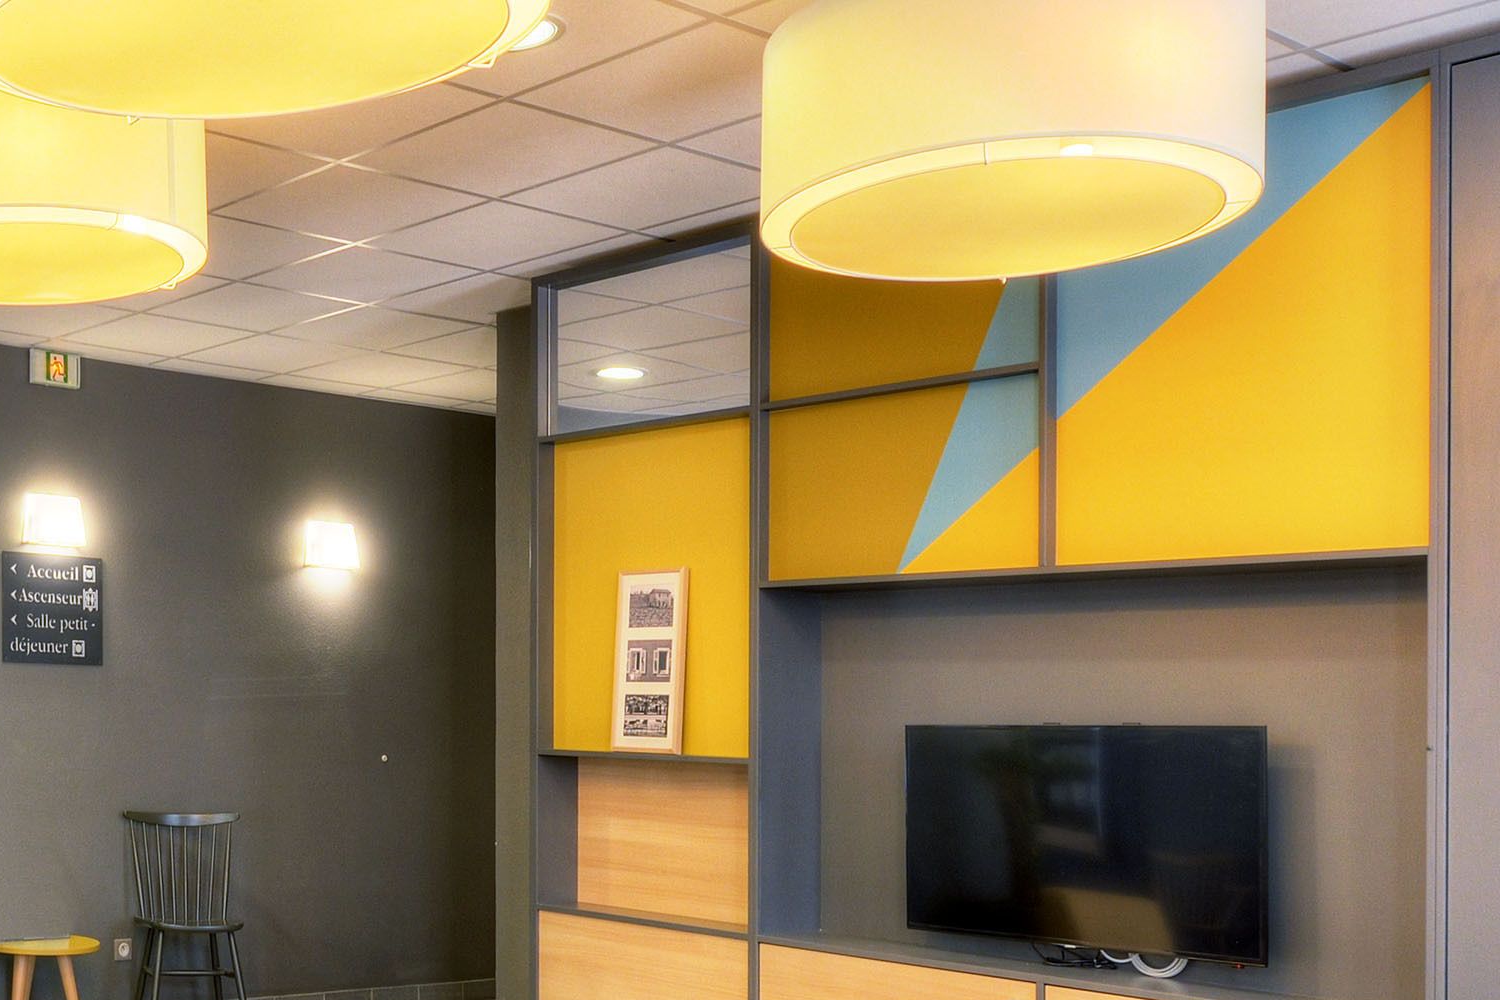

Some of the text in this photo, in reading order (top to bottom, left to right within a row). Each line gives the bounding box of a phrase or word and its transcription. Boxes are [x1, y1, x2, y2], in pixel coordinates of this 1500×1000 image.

[27, 564, 79, 581] Accueil
[19, 588, 83, 605] Ascenseur
[26, 613, 56, 629] Salle
[10, 637, 68, 656] déjeuner
